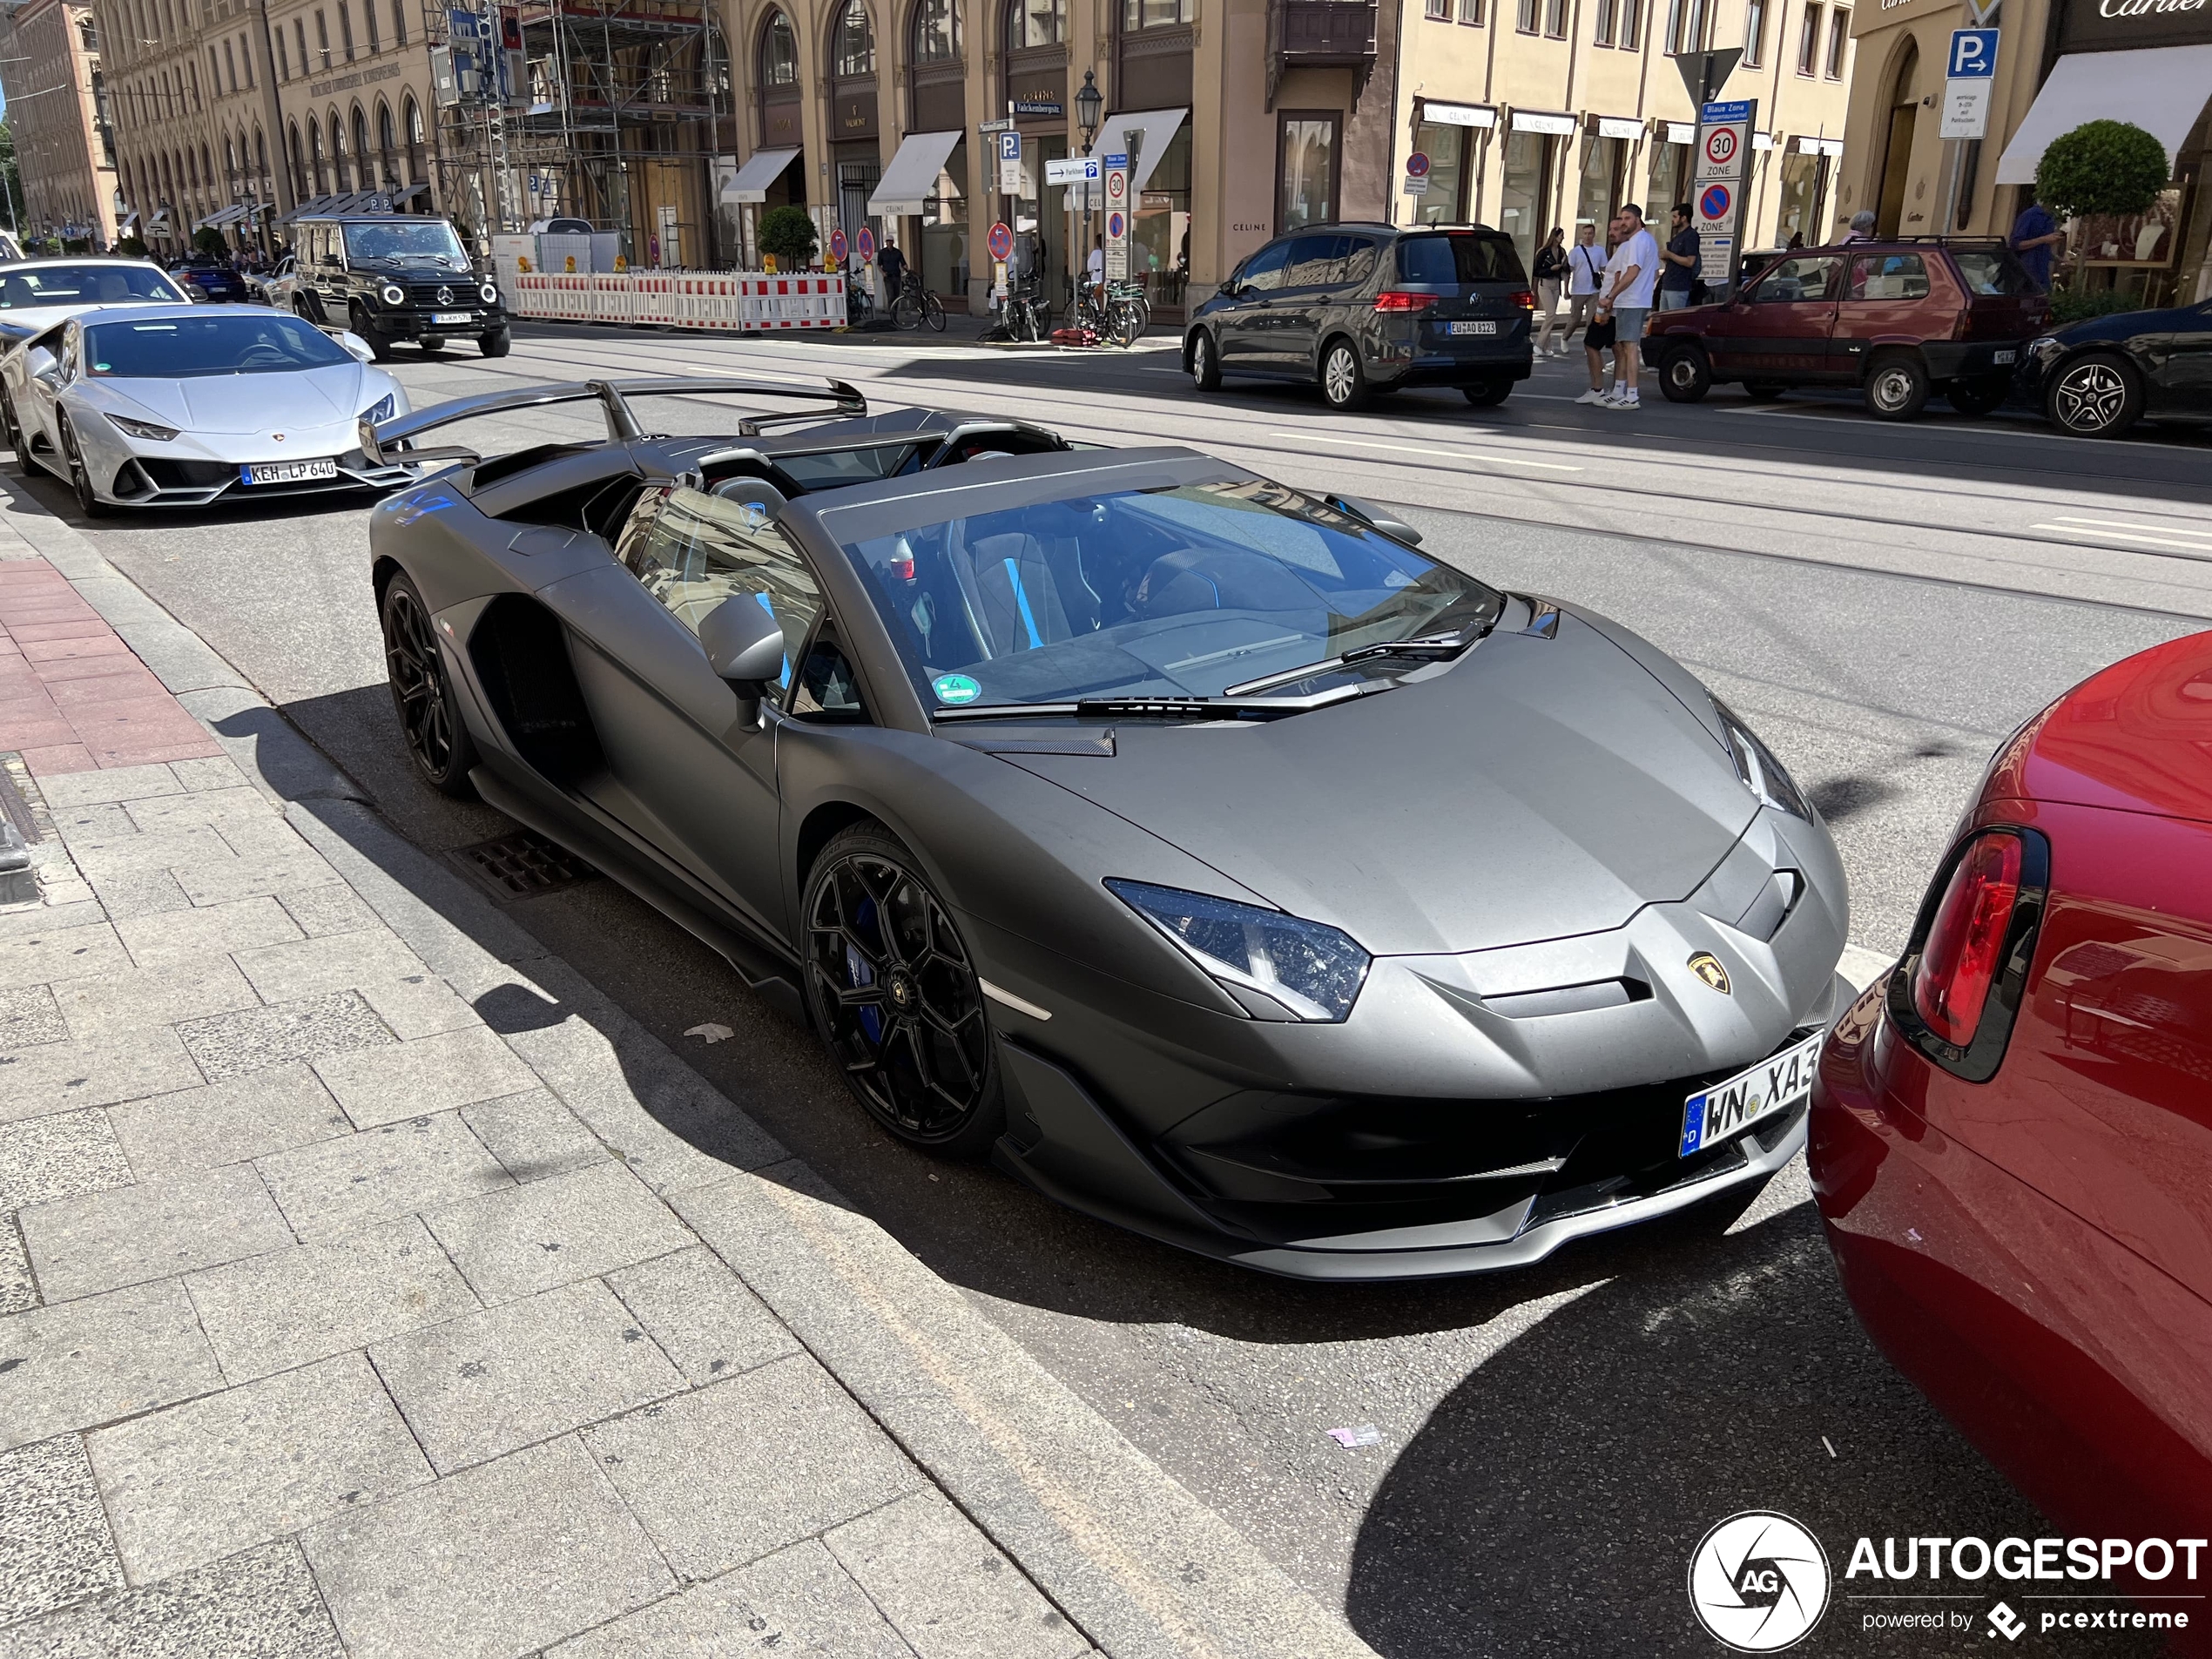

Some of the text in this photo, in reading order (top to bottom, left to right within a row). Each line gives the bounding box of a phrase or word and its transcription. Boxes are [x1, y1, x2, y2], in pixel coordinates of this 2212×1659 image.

[1955, 37, 1983, 71] P
[1002, 137, 1015, 157] P
[1712, 138, 1730, 154] 30
[1707, 165, 1730, 176] ZONE
[1111, 179, 1121, 192] 30
[1232, 223, 1266, 232] CELINE
[1701, 222, 1723, 232] ZONE
[251, 461, 334, 482] KEH LP 640
[949, 678, 962, 689] 4
[1705, 1080, 1748, 1141] WN
[1688, 1130, 1696, 1143] D
